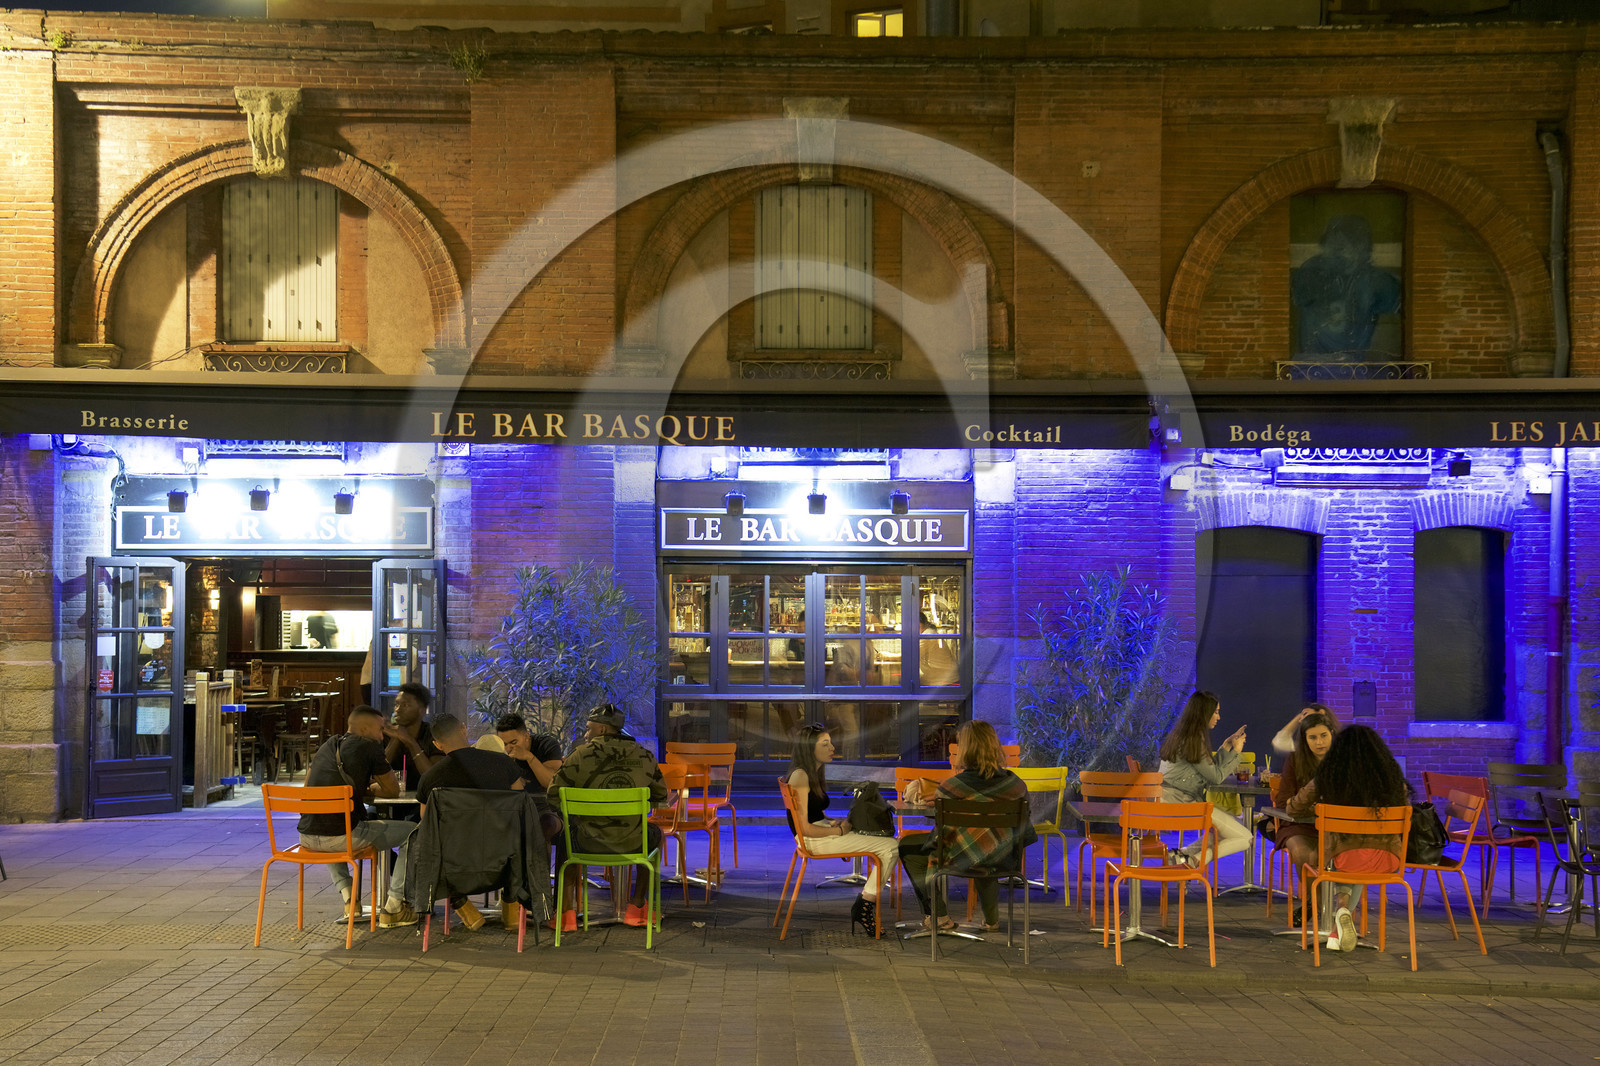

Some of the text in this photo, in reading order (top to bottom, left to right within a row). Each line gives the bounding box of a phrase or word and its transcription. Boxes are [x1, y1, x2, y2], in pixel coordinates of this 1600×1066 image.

[81, 410, 189, 431] Brasserie
[430, 412, 736, 446] LE BAR BASQUE
[1489, 421, 1544, 442] LES
[964, 425, 1061, 443] Cocktail
[1229, 424, 1311, 447] Bodéga
[143, 515, 181, 539] LE
[196, 515, 262, 540] AR
[686, 517, 722, 541] LE
[740, 517, 801, 542] BAR
